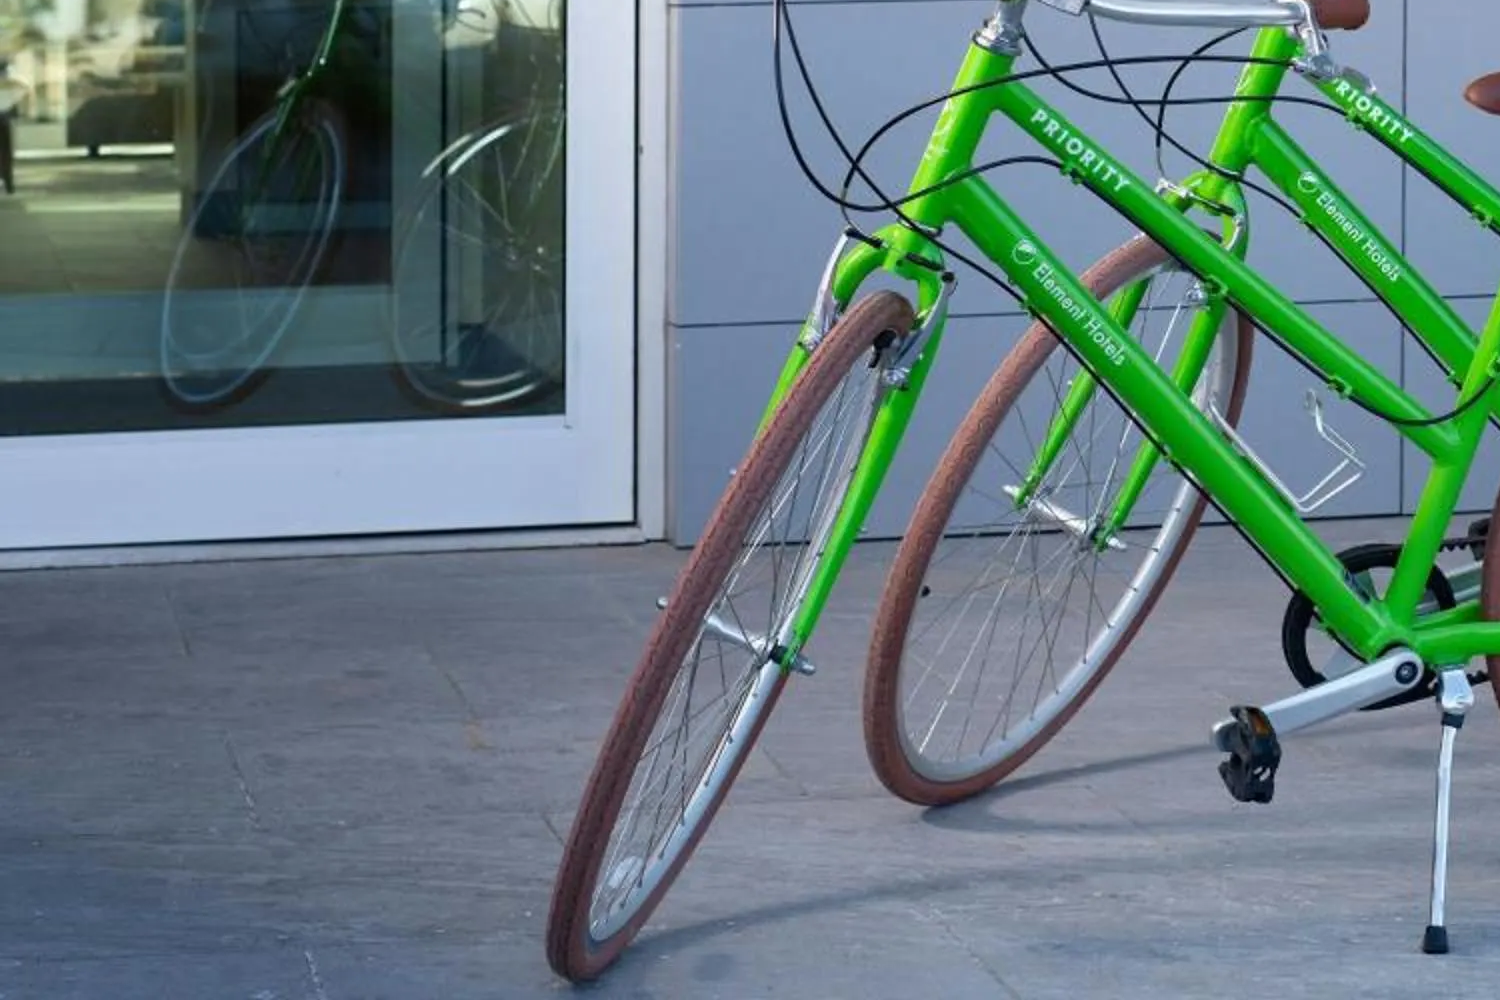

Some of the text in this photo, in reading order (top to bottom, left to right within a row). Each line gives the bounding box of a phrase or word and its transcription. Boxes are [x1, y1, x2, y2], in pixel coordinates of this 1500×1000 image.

[1030, 108, 1130, 191] PRIORITY
[1332, 77, 1413, 143] RIORITY
[1316, 191, 1401, 282] Element Hotels
[1032, 262, 1125, 366] Element Hotels
